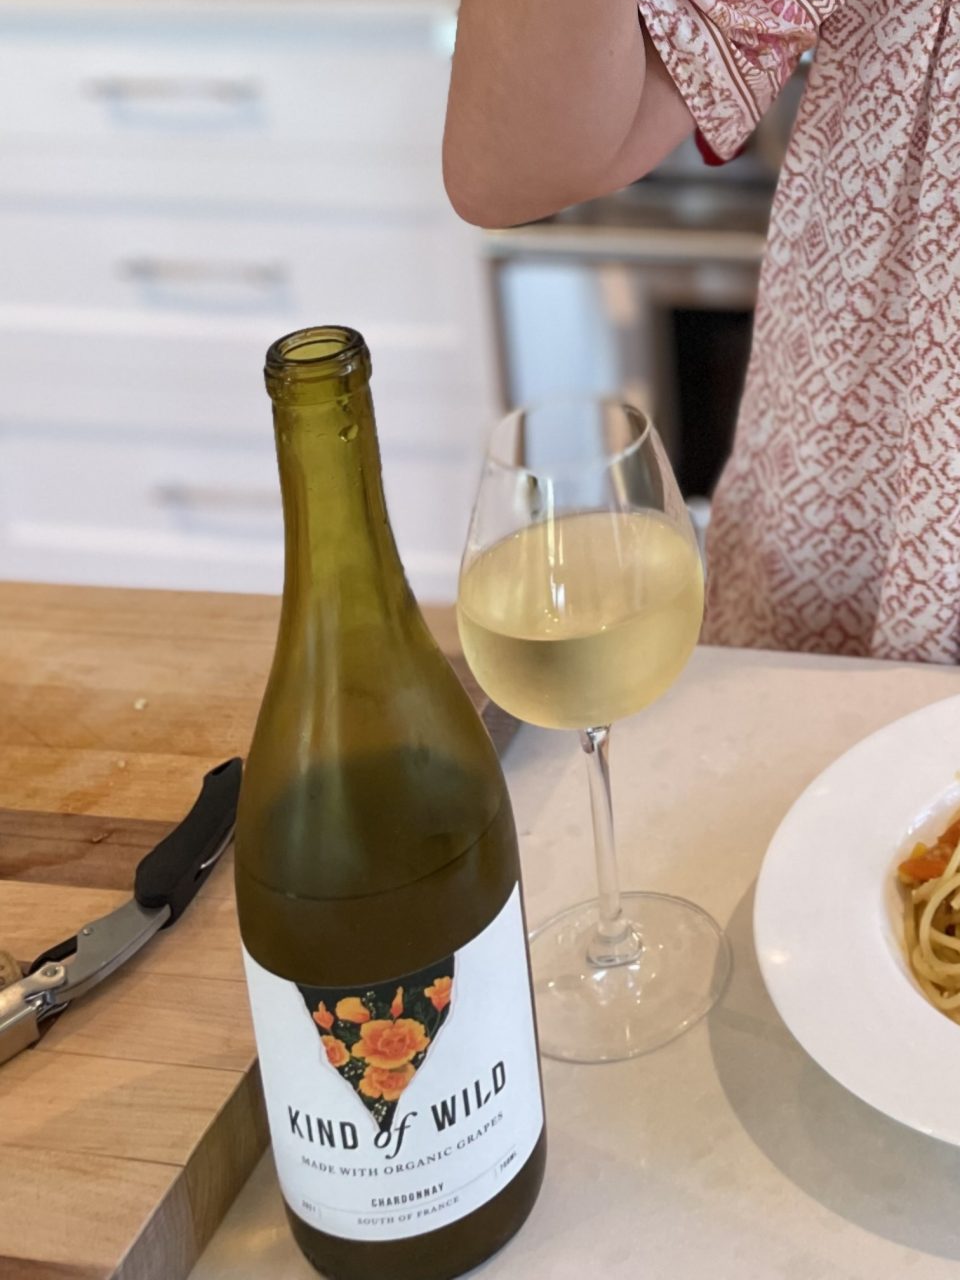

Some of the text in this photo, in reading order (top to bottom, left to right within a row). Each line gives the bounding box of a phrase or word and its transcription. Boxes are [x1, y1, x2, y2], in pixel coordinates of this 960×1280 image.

[288, 1060, 506, 1160] KIND of WILD
[301, 1110, 504, 1177] MADE WITH ORGANIC GRAPES
[357, 1195, 460, 1226] SOUTH OF FRANCE
[371, 1182, 445, 1208] CHARDONNAY
